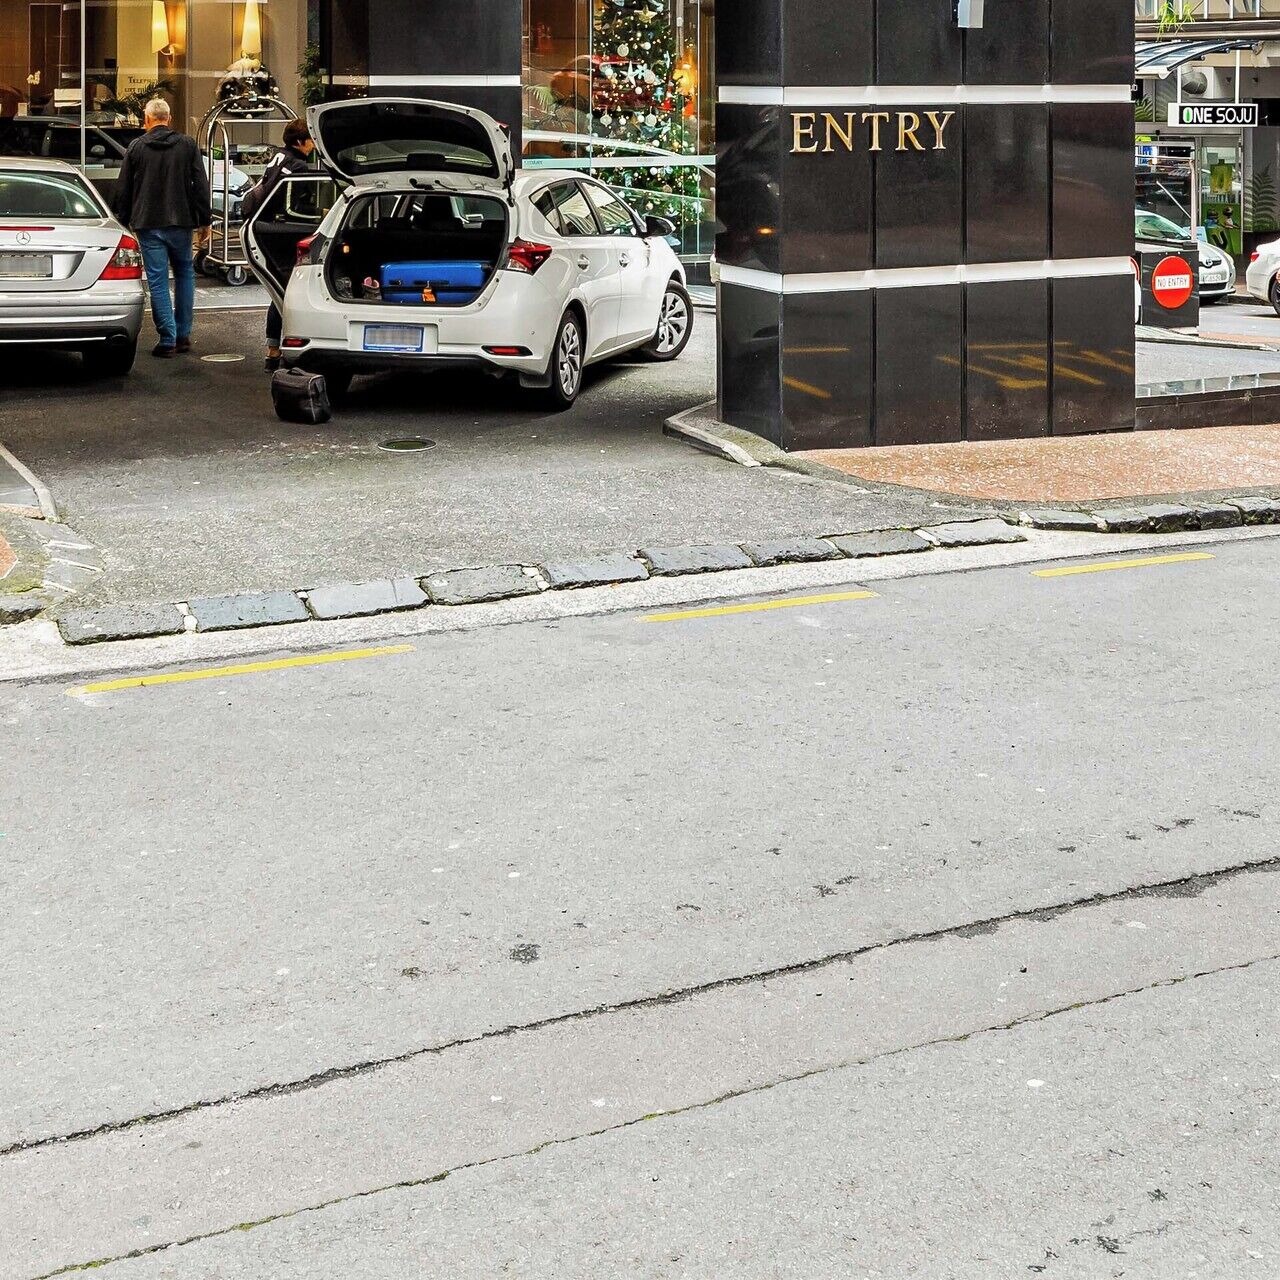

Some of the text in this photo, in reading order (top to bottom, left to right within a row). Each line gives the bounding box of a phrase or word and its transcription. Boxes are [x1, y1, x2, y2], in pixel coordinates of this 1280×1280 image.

[1183, 107, 1253, 124] ONE SOJU
[789, 111, 956, 153] ENTRY
[1157, 276, 1188, 288] NO ENTRY
